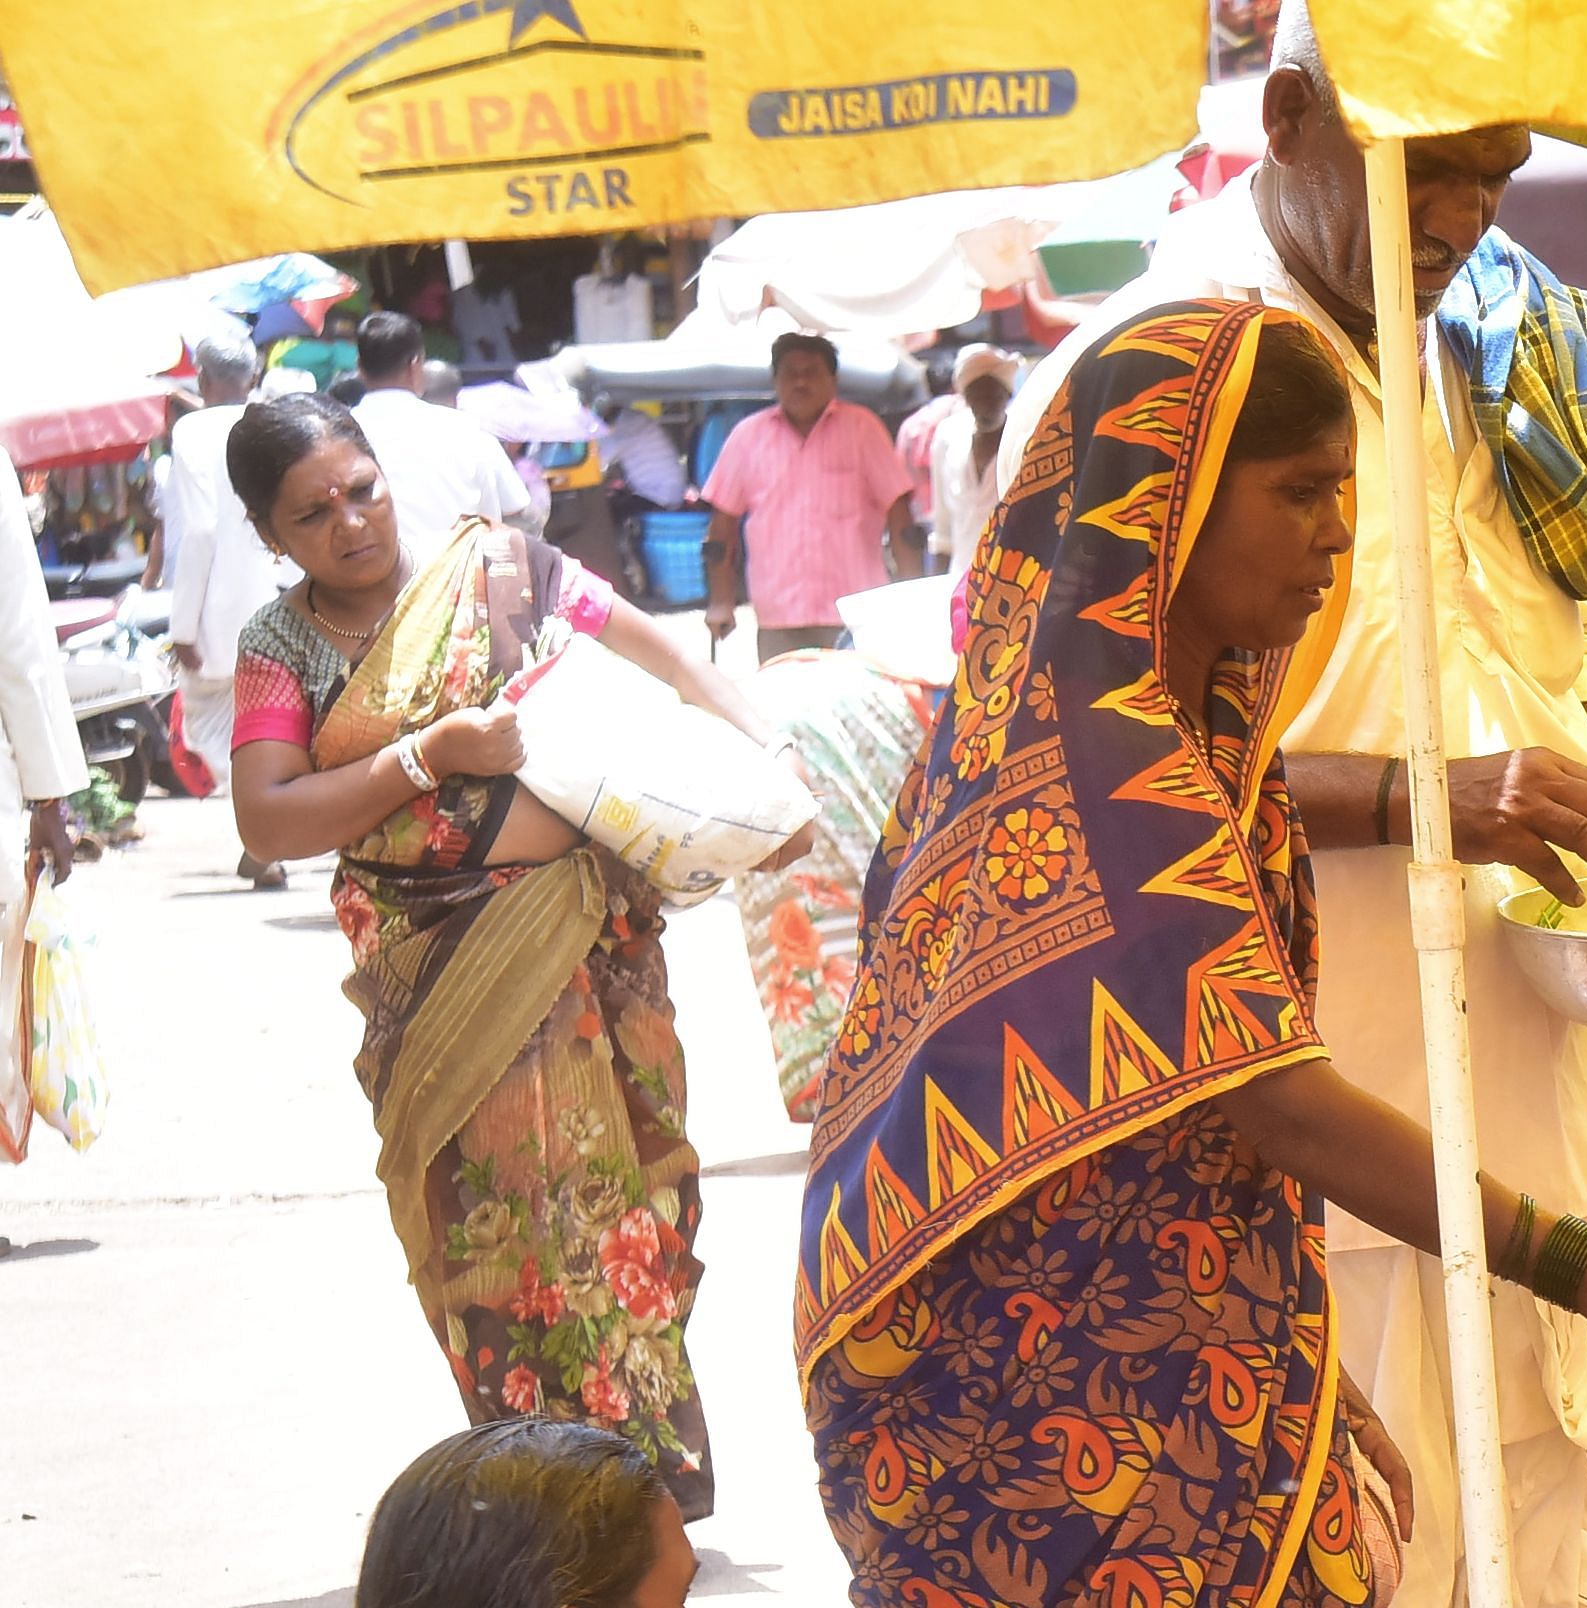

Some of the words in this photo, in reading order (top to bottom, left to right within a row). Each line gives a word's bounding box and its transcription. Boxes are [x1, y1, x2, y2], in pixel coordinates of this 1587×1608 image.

[777, 88, 884, 134] JAISA
[891, 80, 937, 124] KOI
[949, 74, 1050, 116] NAHI
[506, 167, 636, 217] STAR
